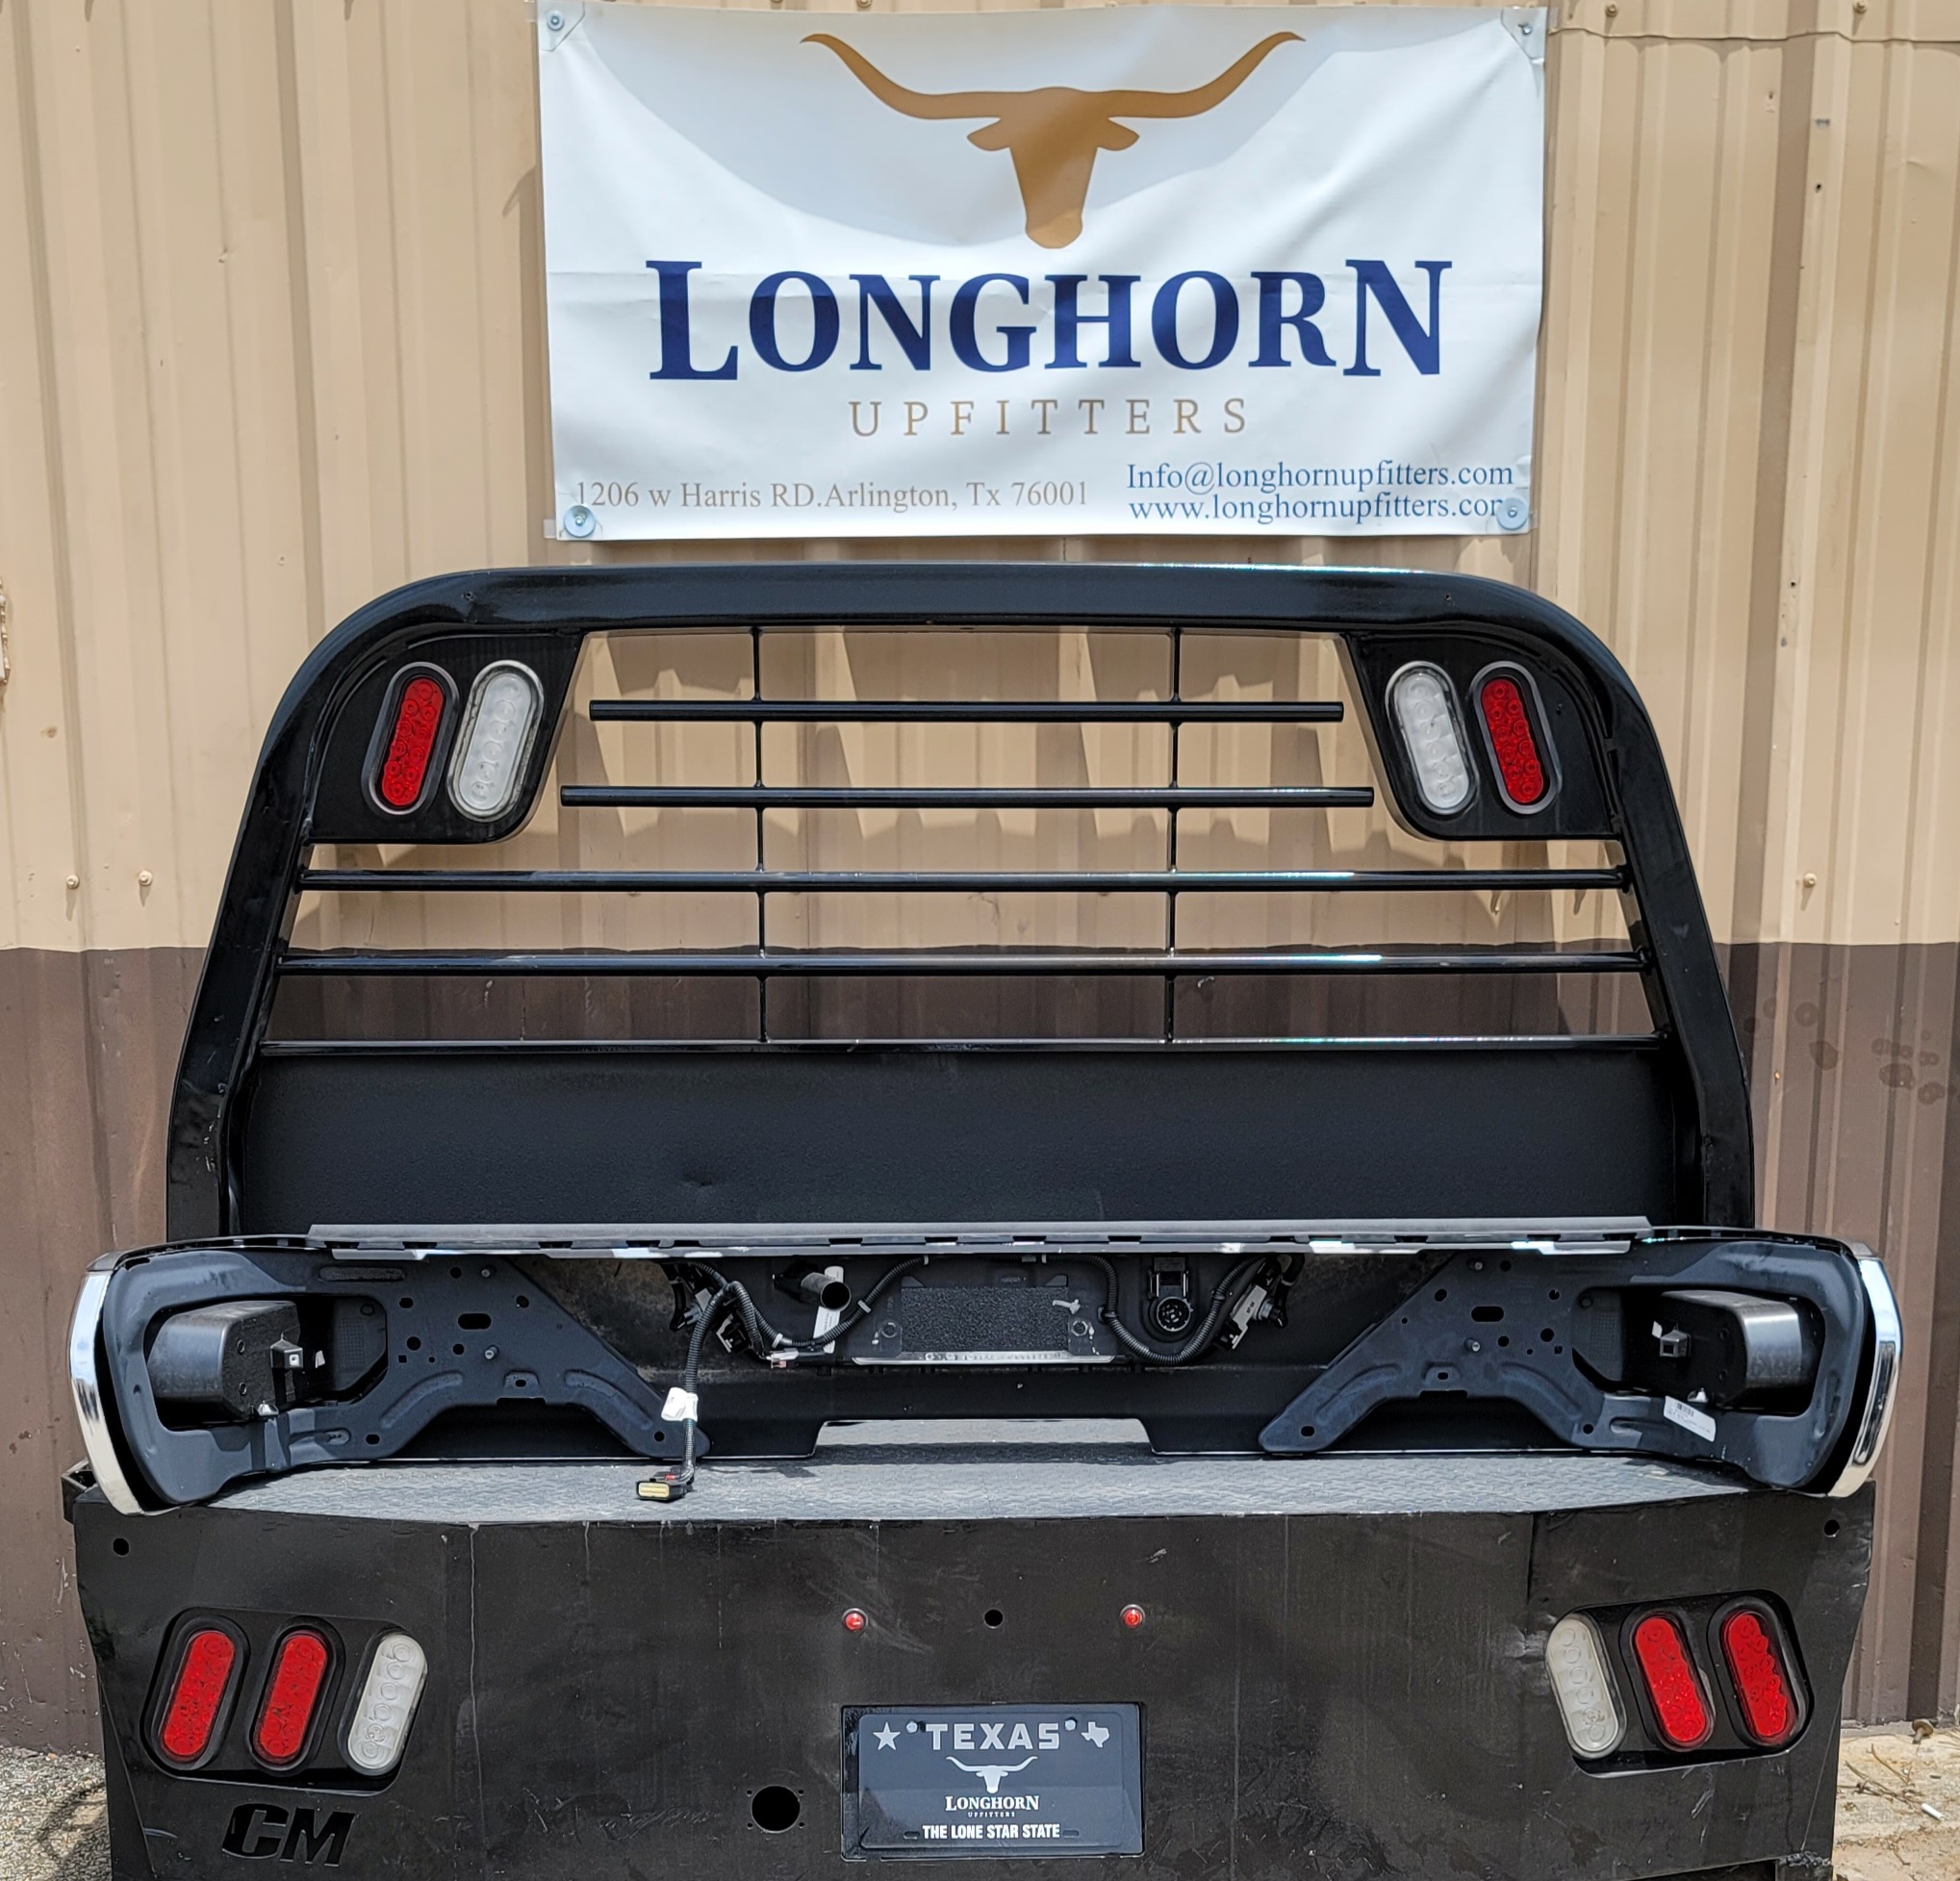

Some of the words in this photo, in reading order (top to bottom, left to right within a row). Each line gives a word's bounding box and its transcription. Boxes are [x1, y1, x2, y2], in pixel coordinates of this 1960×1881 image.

[646, 260, 1453, 380] LONGHORN
[849, 397, 1246, 437] UPFITTERS
[1127, 460, 1514, 495] Info@longhornupfitters.com
[577, 481, 639, 507] 1206
[648, 489, 672, 507] w
[680, 481, 761, 507] Harris
[966, 482, 1002, 506] Tx
[1010, 481, 1086, 506] 76001
[926, 1723, 1059, 1751] TEXAS
[945, 1795, 1039, 1812] LONGHORN
[222, 1803, 355, 1868] CM
[922, 1824, 948, 1840] THE
[951, 1824, 983, 1840] LONE
[986, 1824, 1019, 1840] STAR
[1022, 1823, 1060, 1839] STATE
